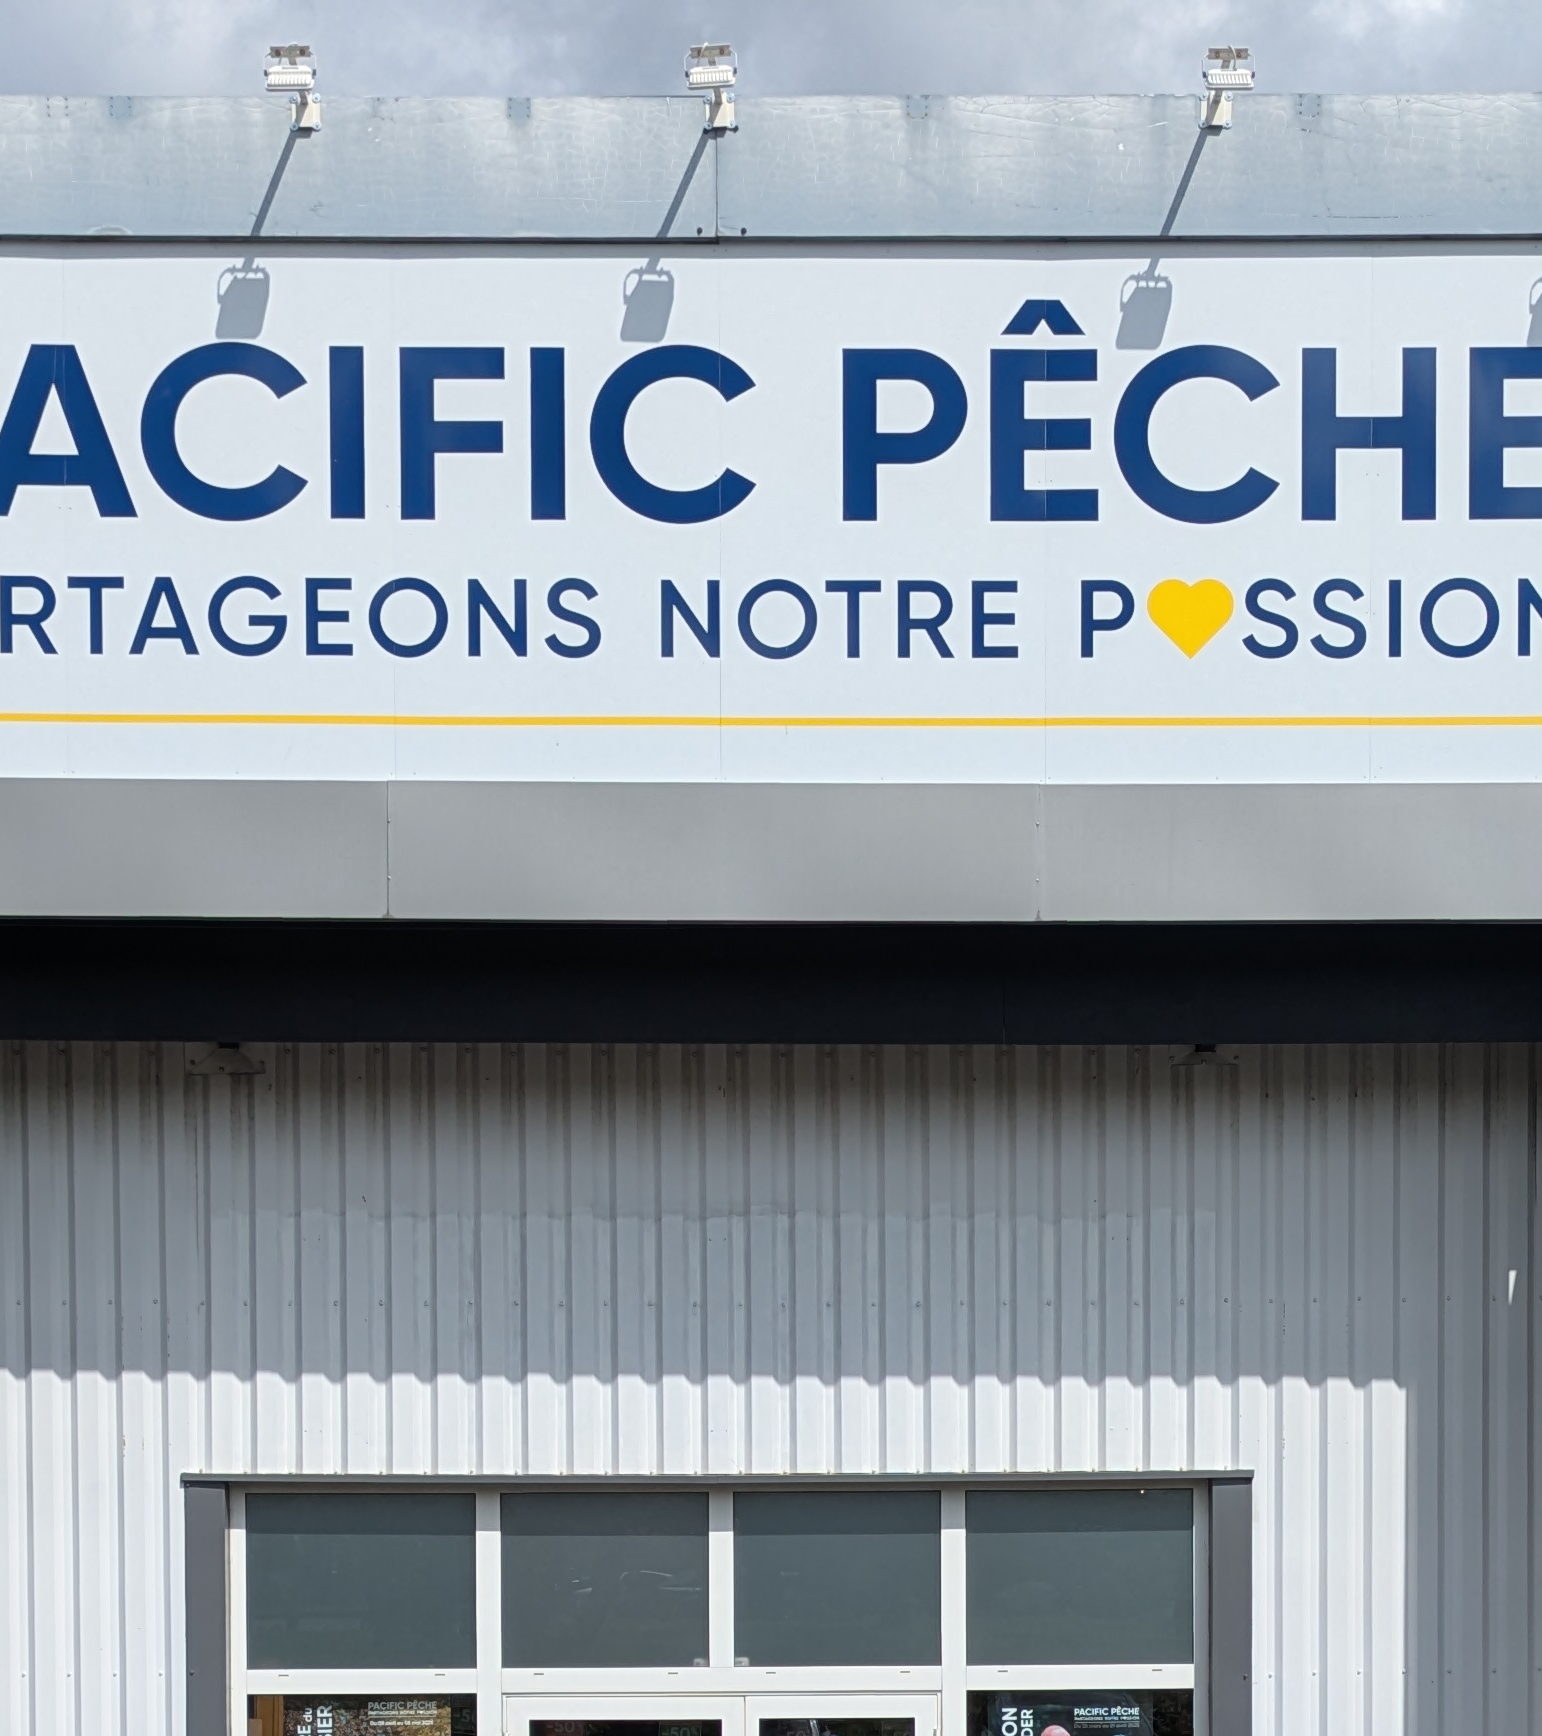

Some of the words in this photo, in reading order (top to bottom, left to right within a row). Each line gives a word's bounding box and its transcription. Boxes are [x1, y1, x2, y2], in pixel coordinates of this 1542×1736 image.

[662, 579, 1018, 658] NOTRE
[368, 1701, 404, 1710] PACIFIC
[407, 1699, 437, 1710] PÊCHE
[1074, 1707, 1109, 1716] PACIFIC
[1111, 1705, 1140, 1716] PÊCHE
[303, 1707, 313, 1722] du
